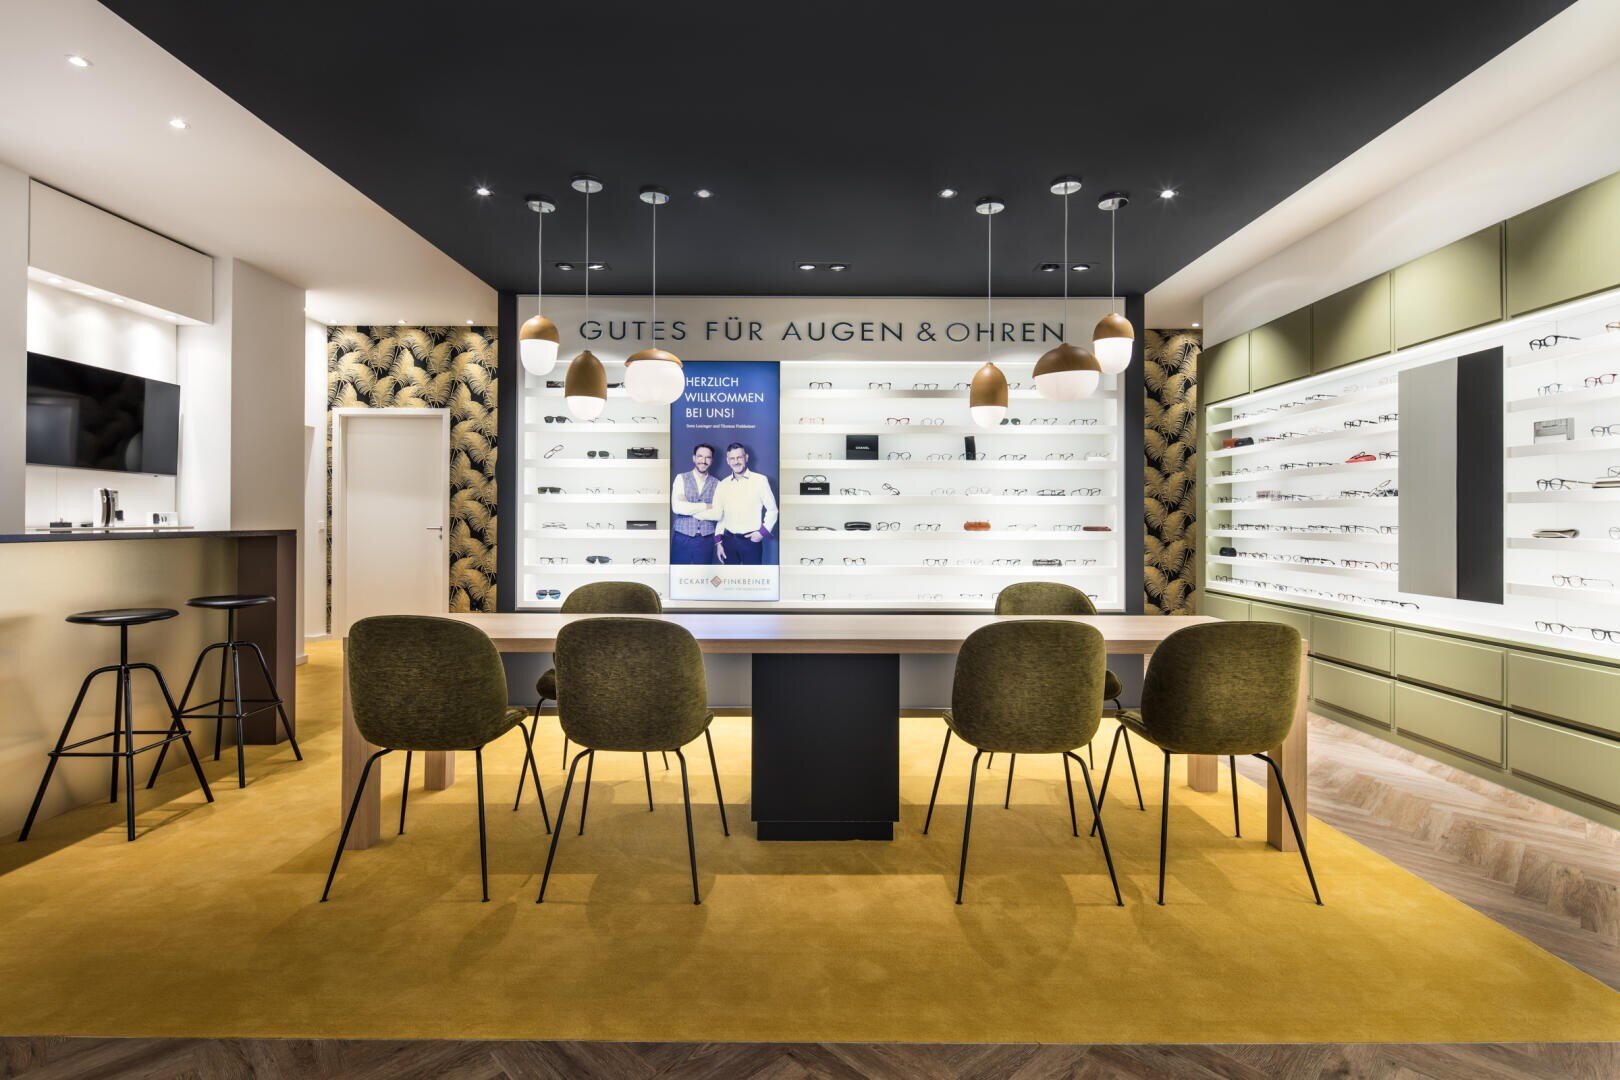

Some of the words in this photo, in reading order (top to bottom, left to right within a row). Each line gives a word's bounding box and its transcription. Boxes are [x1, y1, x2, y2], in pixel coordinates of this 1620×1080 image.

[579, 320, 687, 341] GUTES
[705, 316, 763, 342] FÜR
[781, 321, 903, 342] AUGEN
[916, 321, 937, 342] &
[946, 322, 1065, 342] OHREN
[685, 376, 739, 387] HERZLICH
[684, 392, 764, 403] WILLKOMMEN
[685, 407, 702, 418] BEI
[706, 407, 735, 418] UNS!
